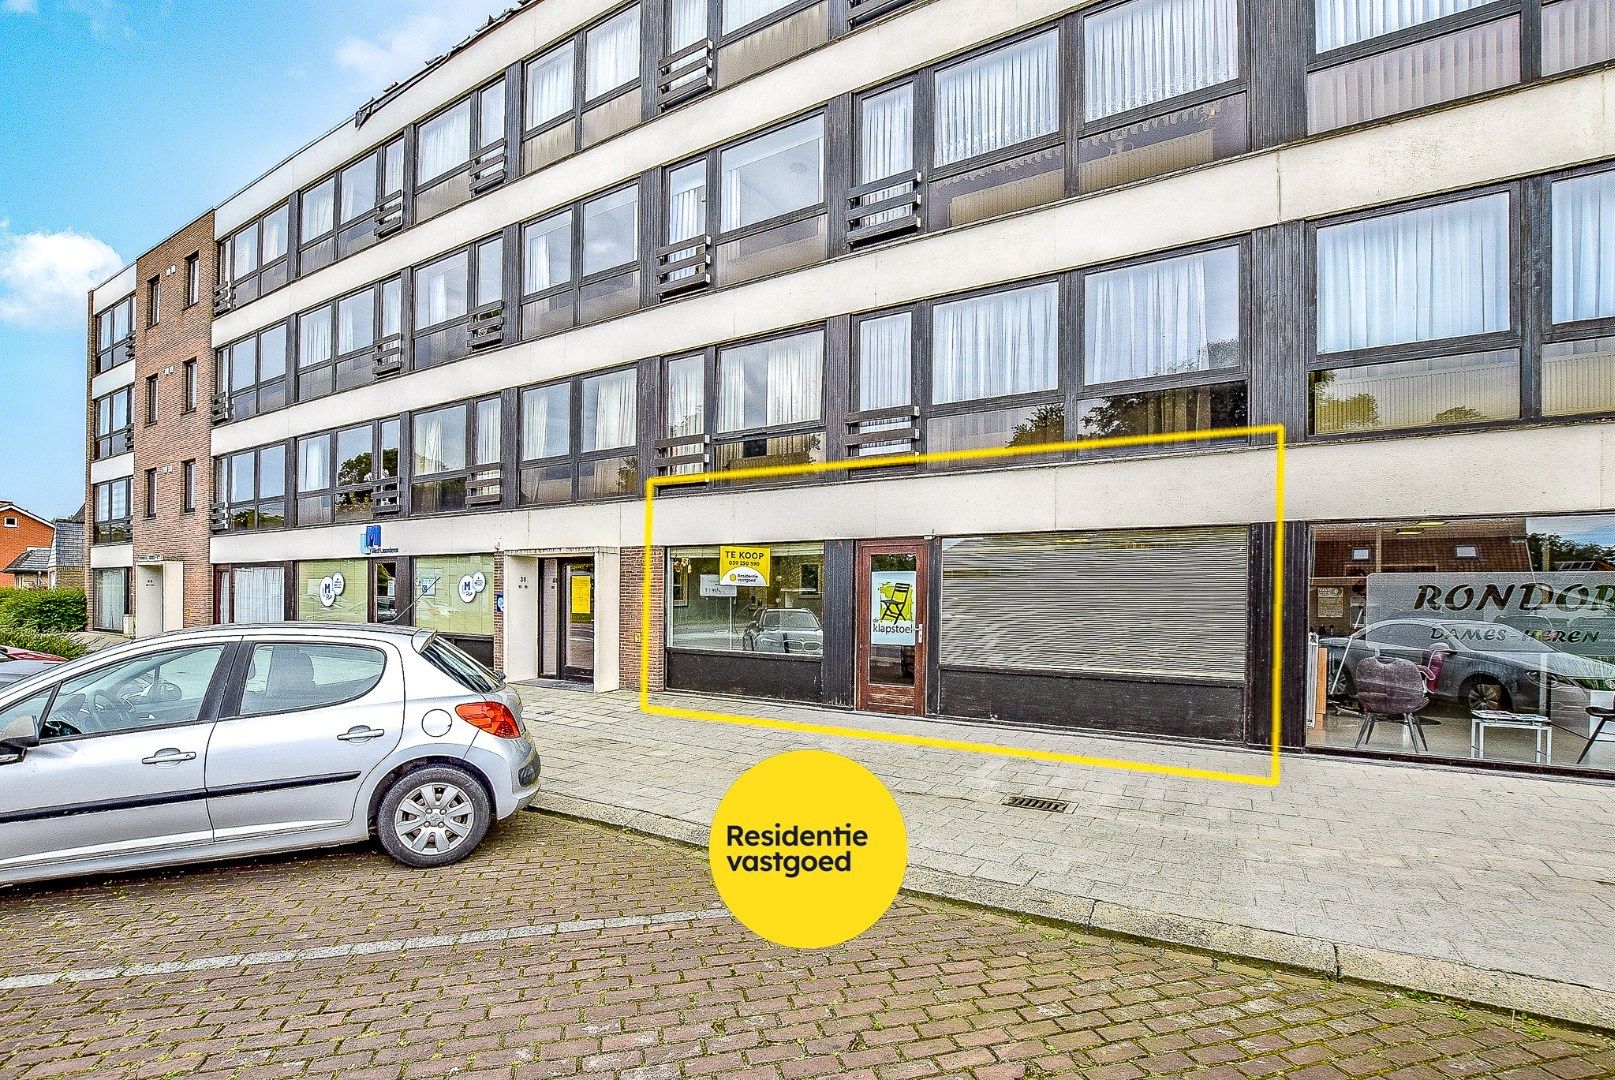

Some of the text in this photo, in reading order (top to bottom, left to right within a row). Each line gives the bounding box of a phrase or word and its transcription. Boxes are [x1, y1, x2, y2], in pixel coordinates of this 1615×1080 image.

[725, 550, 764, 560] TE KOOP
[872, 623, 913, 635] klapstoel
